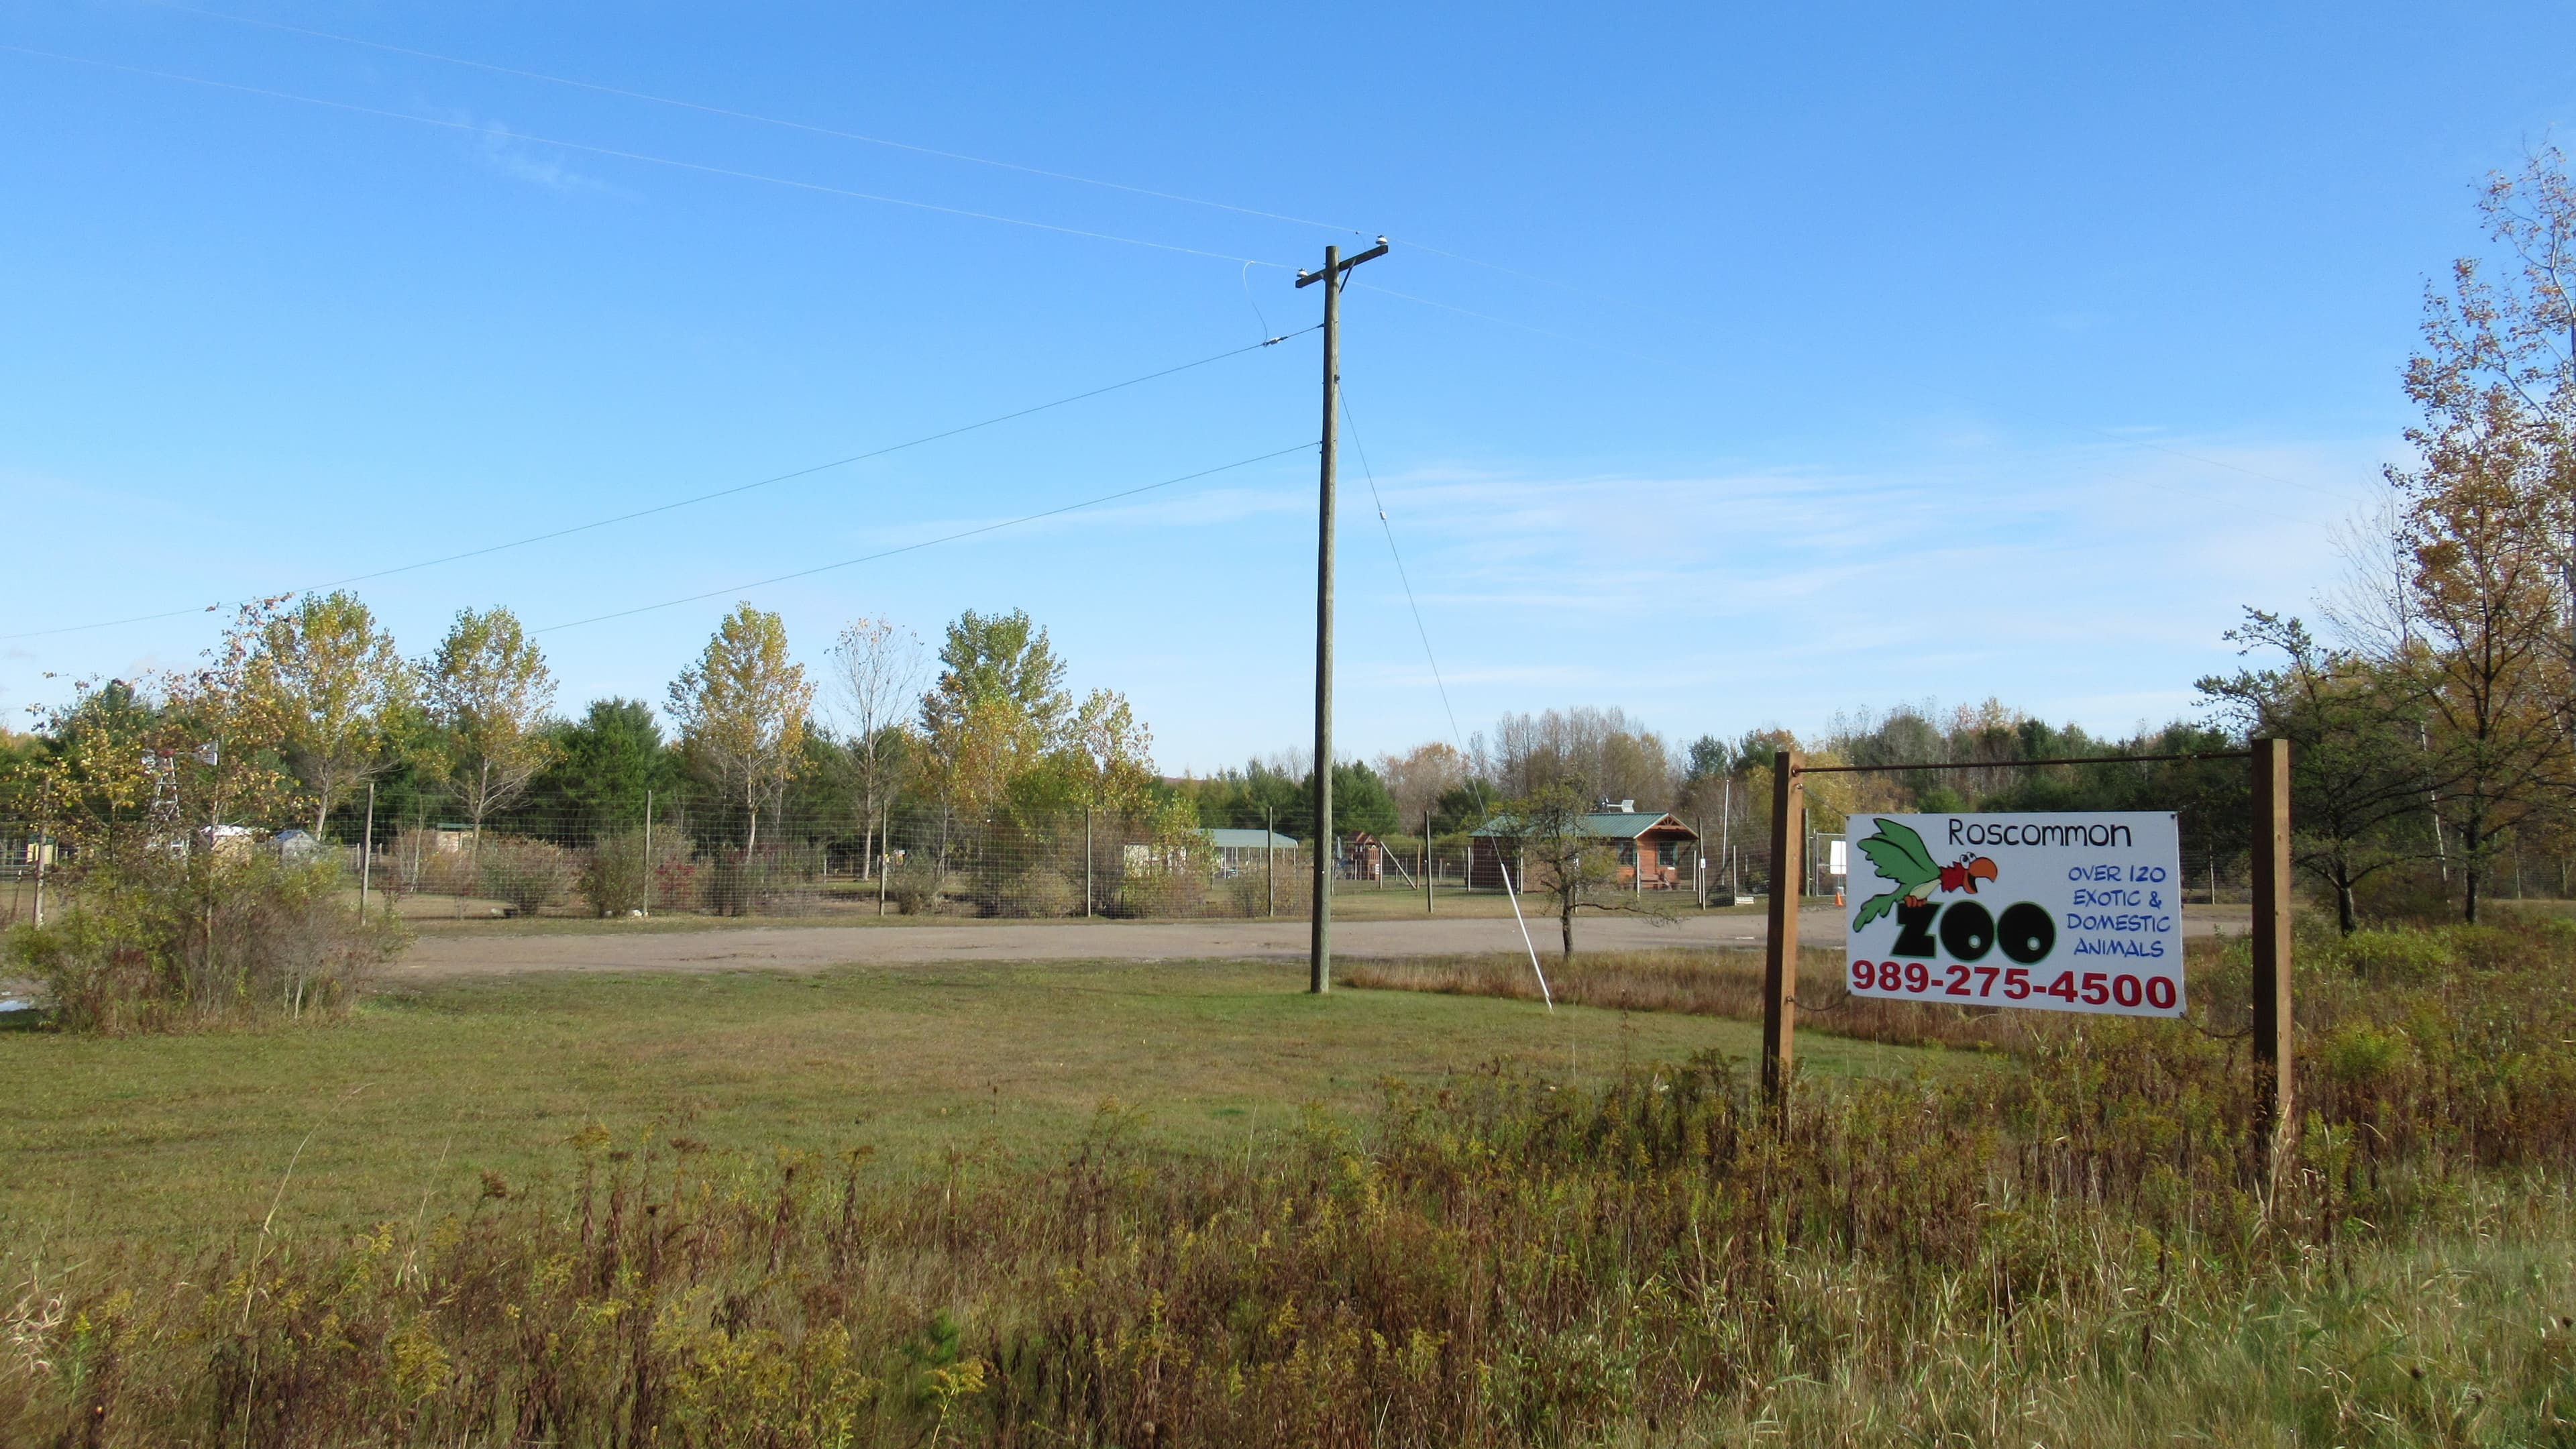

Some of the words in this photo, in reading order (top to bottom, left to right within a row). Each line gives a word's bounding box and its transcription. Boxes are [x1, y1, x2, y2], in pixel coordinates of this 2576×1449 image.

[1949, 818, 2132, 847] Roscommon
[2068, 865, 2121, 882] OVER
[2130, 865, 2165, 882] 120
[2073, 889, 2142, 907] EXOTIC
[2149, 892, 2162, 909] &
[1889, 900, 2056, 965] ZOO
[2067, 914, 2170, 932] DOMESTIC
[2074, 937, 2164, 957] ANIMALS
[1851, 959, 2177, 1009] 989-275-4500
